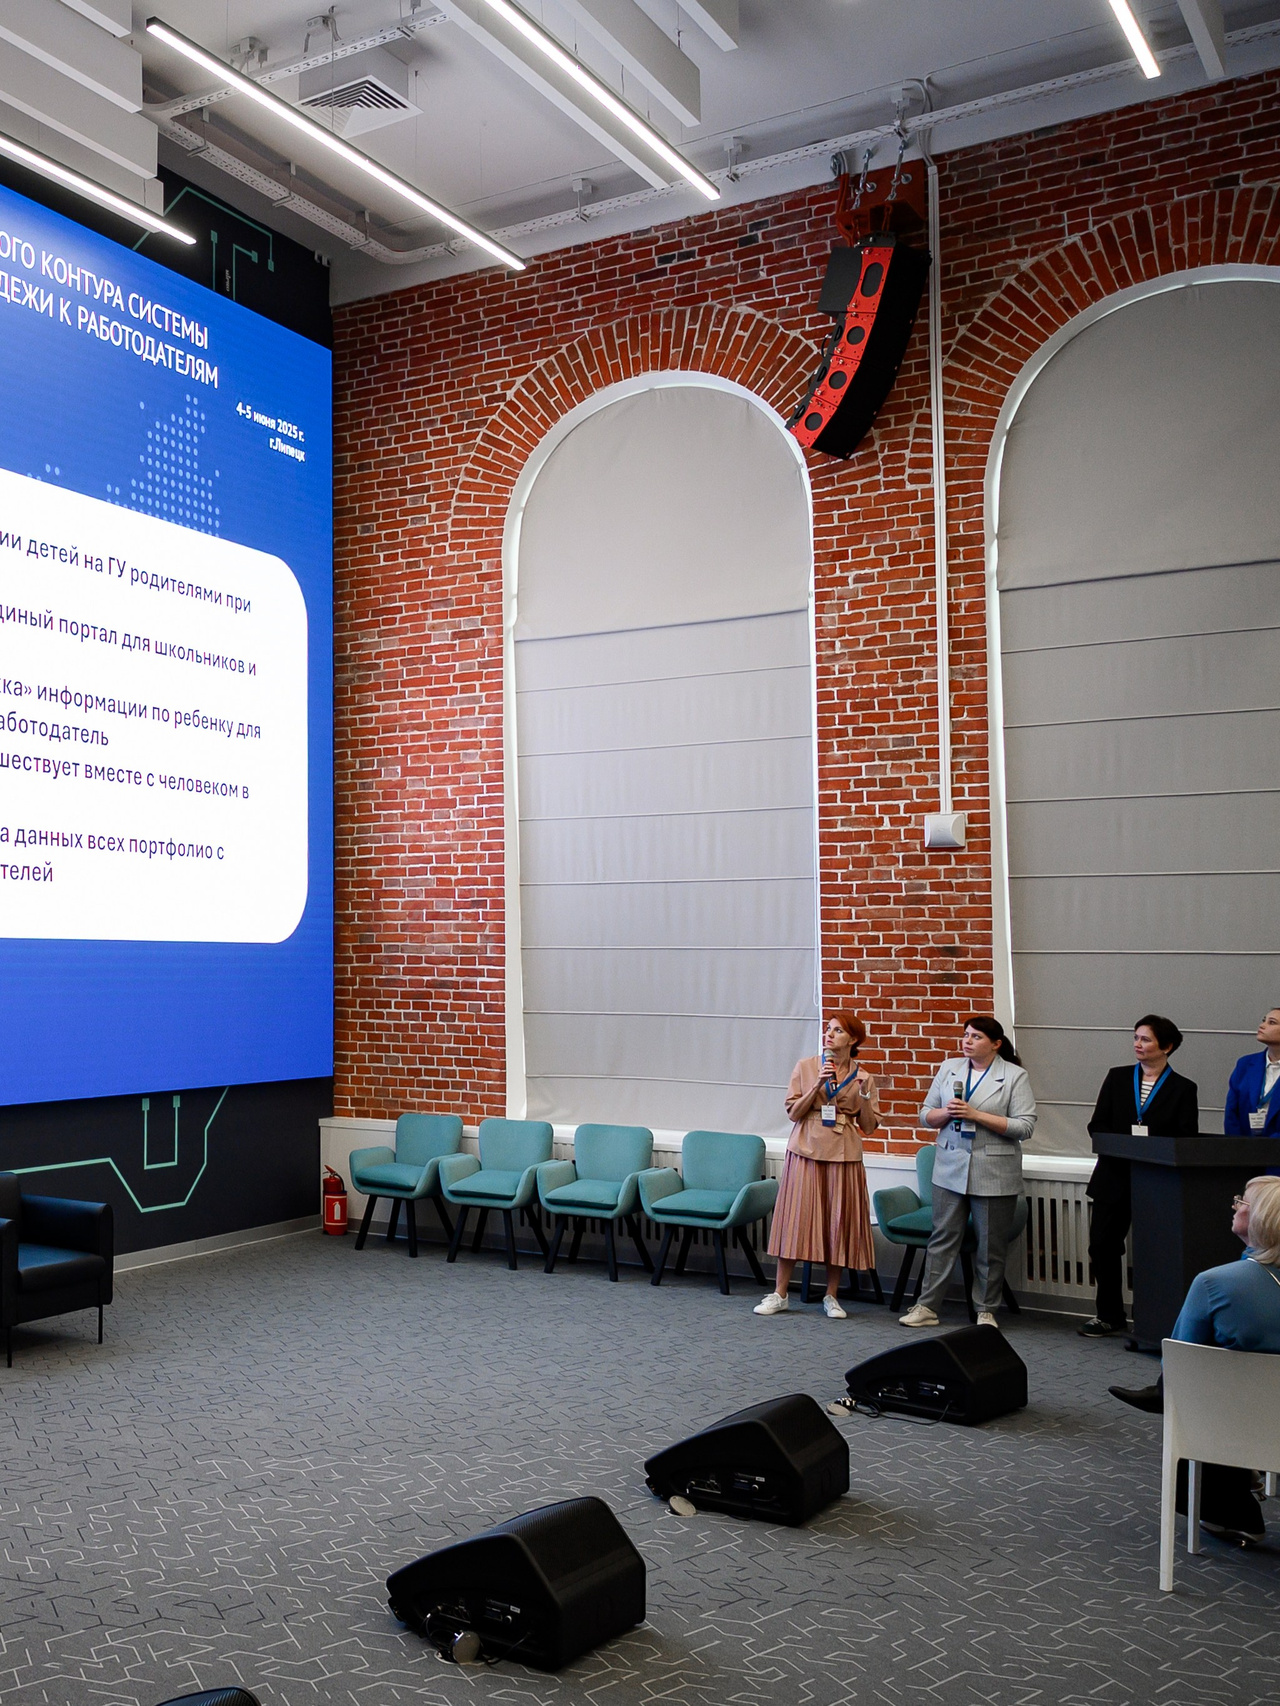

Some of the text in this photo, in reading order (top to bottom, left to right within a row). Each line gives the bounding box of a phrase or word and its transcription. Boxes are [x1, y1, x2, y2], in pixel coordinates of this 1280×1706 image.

[41, 250, 125, 312] КОНТУРА
[128, 292, 208, 350] СИСТЕМЫ
[59, 297, 72, 326] К
[77, 305, 218, 389] РАБОТОДАТЕЛЯМ
[236, 402, 305, 442] 4-5 июня 2025 г.
[26, 538, 79, 567] детей
[84, 554, 103, 573] на
[108, 556, 127, 578] ГУ
[130, 567, 222, 606] родителями
[226, 594, 251, 614] при
[59, 617, 118, 645] портал
[121, 632, 151, 653] для
[154, 640, 245, 674] школьников
[248, 662, 256, 677] и
[37, 685, 147, 719] информации
[152, 706, 170, 723] по
[174, 709, 234, 738] ребенку
[236, 722, 261, 740] для
[84, 763, 143, 786] вместе
[146, 772, 155, 787] с
[158, 774, 238, 798] человеком
[242, 785, 250, 800] в
[13, 828, 84, 849] данных
[87, 834, 125, 853] всех
[129, 837, 213, 861] портфолио
[216, 846, 225, 860] с
